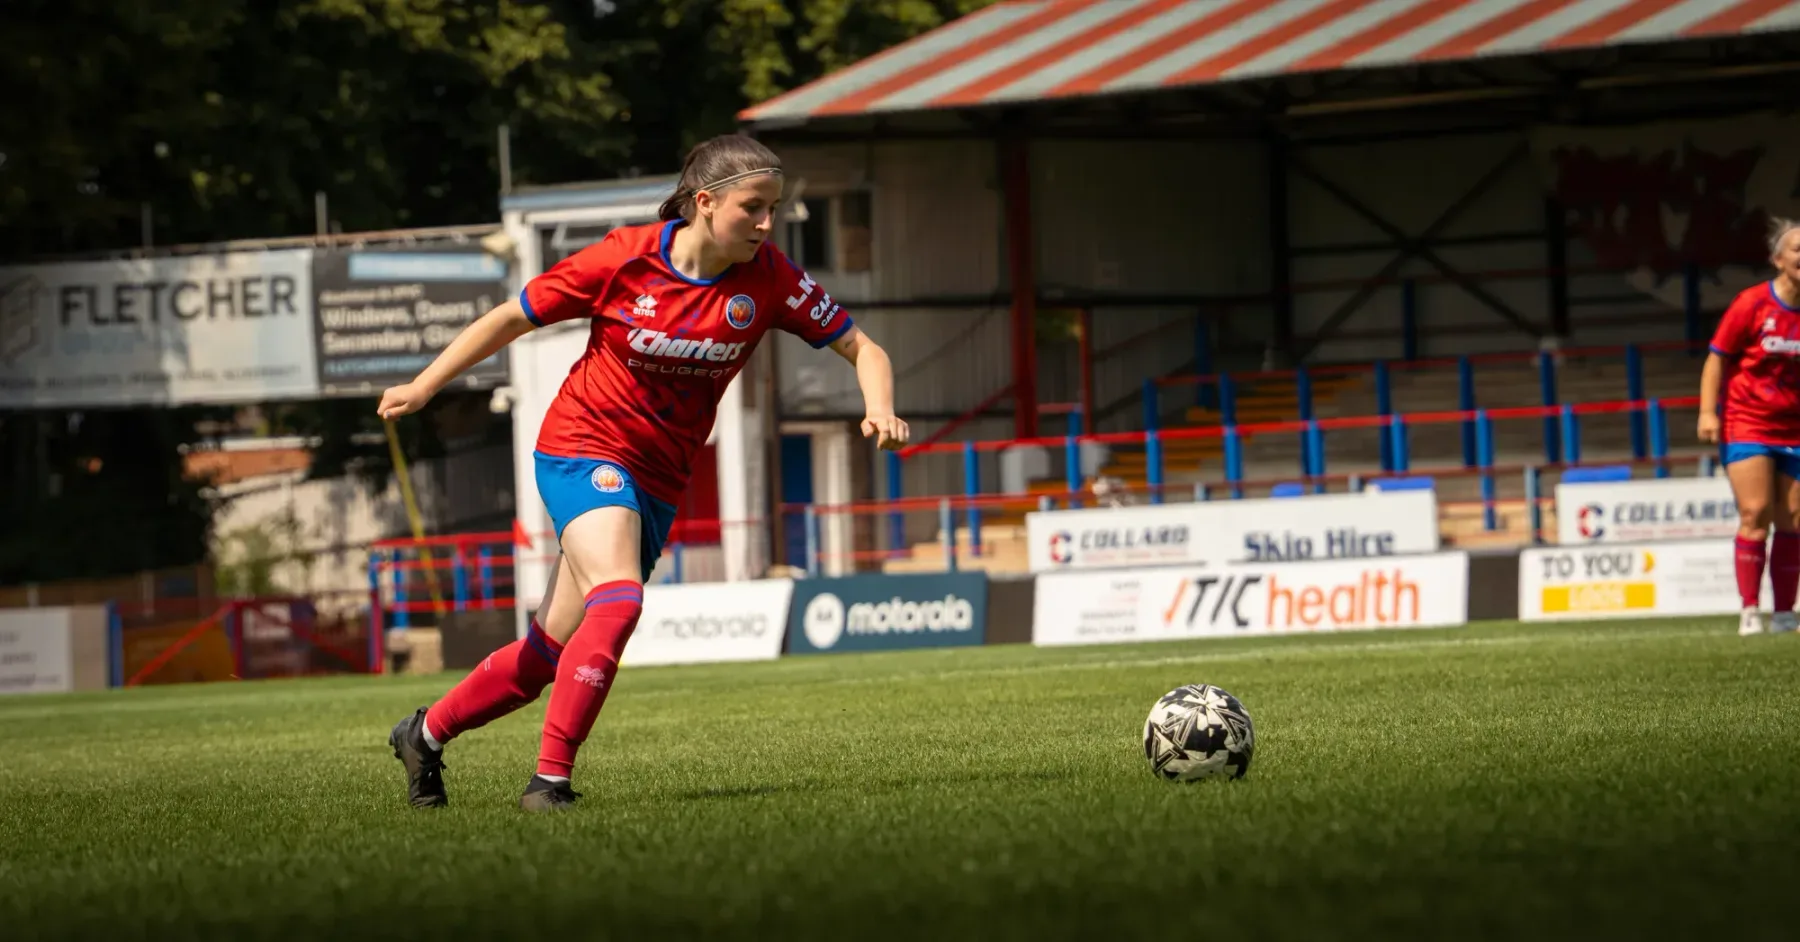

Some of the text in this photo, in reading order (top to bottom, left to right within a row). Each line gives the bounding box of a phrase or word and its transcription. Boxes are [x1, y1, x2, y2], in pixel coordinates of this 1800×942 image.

[58, 274, 297, 327] FLETCHER
[627, 328, 747, 362] Charters
[628, 358, 733, 379] PEUGEOT
[1080, 526, 1189, 549] COLLARD
[1325, 526, 1396, 558] Hire
[1540, 552, 1634, 578] TO YOU
[654, 612, 768, 639] motorola
[847, 595, 973, 634] motorola
